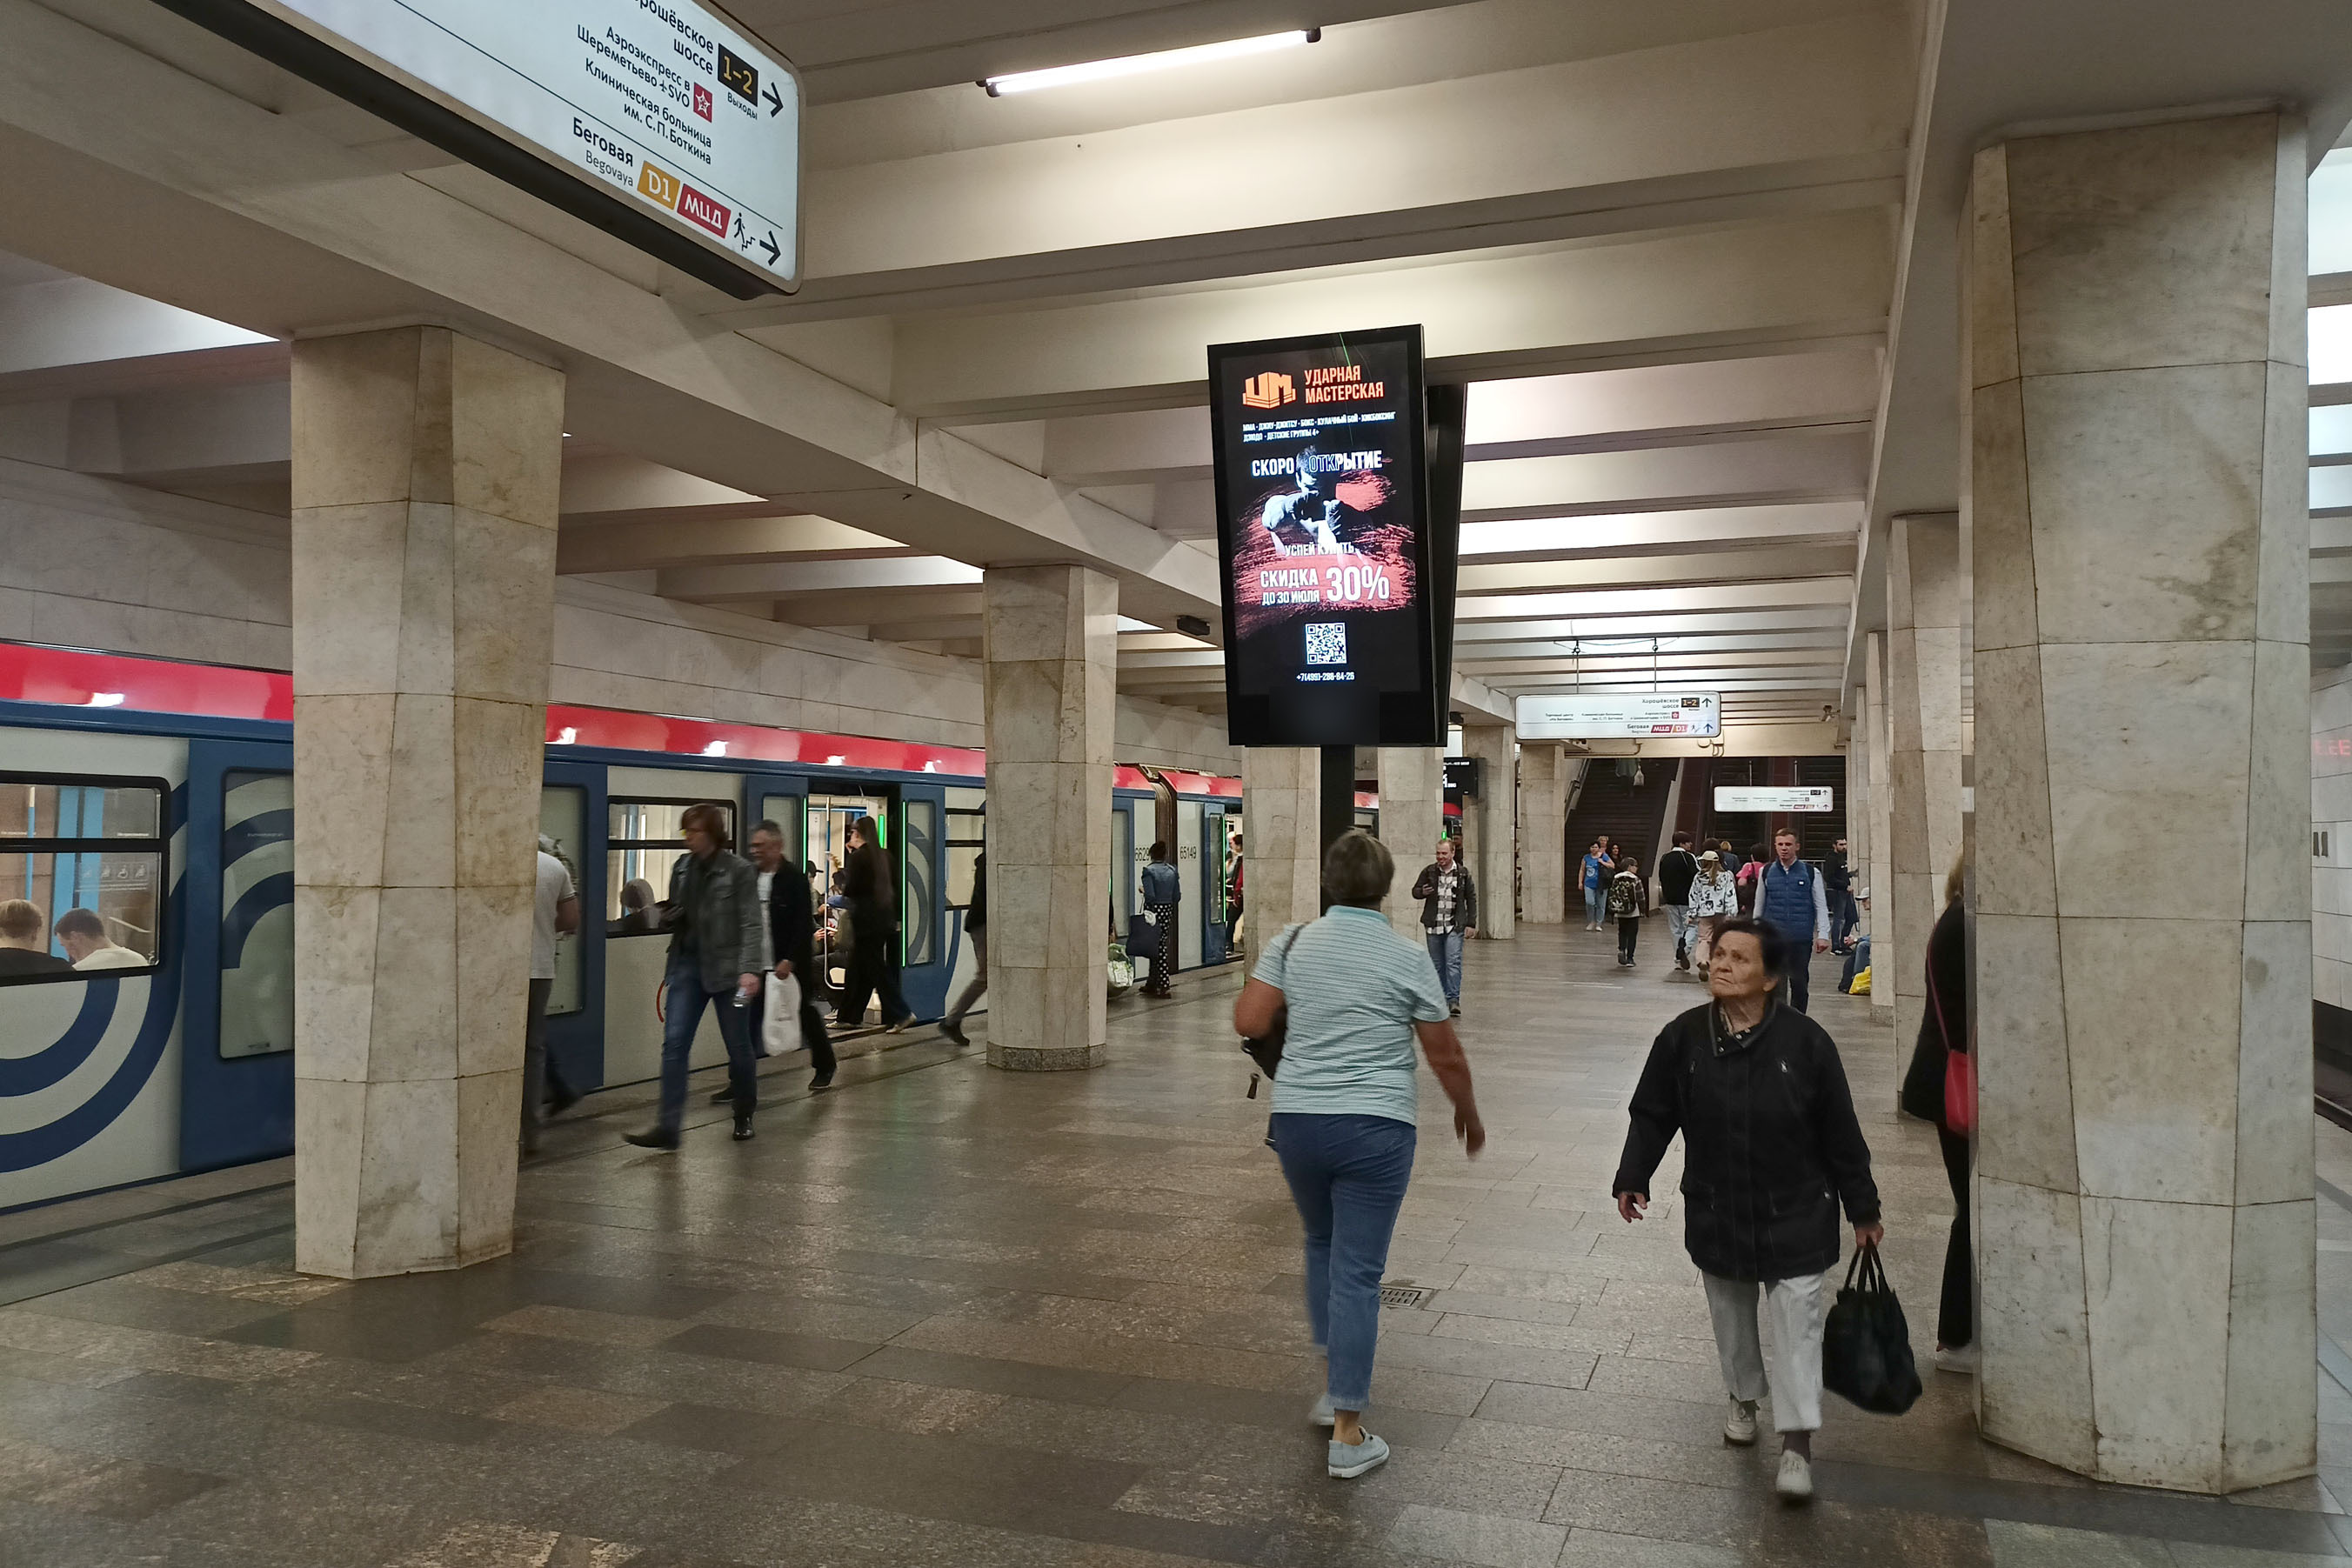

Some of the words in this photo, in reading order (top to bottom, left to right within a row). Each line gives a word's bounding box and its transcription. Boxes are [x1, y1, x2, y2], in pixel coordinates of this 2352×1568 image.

[636, 0, 713, 54] рошёвское
[578, 24, 658, 86] Шереметьево
[668, 84, 690, 108] SVO
[606, 26, 682, 86] Аэроэкспресс
[685, 80, 691, 91] в
[673, 38, 713, 75] шоссе
[724, 56, 752, 95] 1-2
[585, 57, 659, 116] Клиническая
[663, 108, 712, 148] больница
[625, 103, 643, 123] им.
[727, 91, 758, 120] Выходы
[573, 117, 633, 167] Беговая
[585, 150, 634, 187] Begovaya
[647, 169, 672, 203] D1
[685, 194, 723, 230] МЦД
[1305, 364, 1361, 385] УДАРНАЯ
[1305, 381, 1384, 404] МАСТЕРСКАЯ
[1252, 457, 1295, 477] СКОРО
[1308, 450, 1383, 473] ОТКРЫТИЕ
[1285, 543, 1317, 557] УСПЕЙ
[1260, 568, 1319, 589] СКИДКА
[1325, 565, 1390, 602] 30%
[1261, 591, 1277, 606] ДО
[1277, 591, 1290, 604] 30
[1291, 590, 1320, 604] ИЮЛЯ
[1134, 847, 1150, 861] 6629
[1179, 846, 1197, 859] 65149
